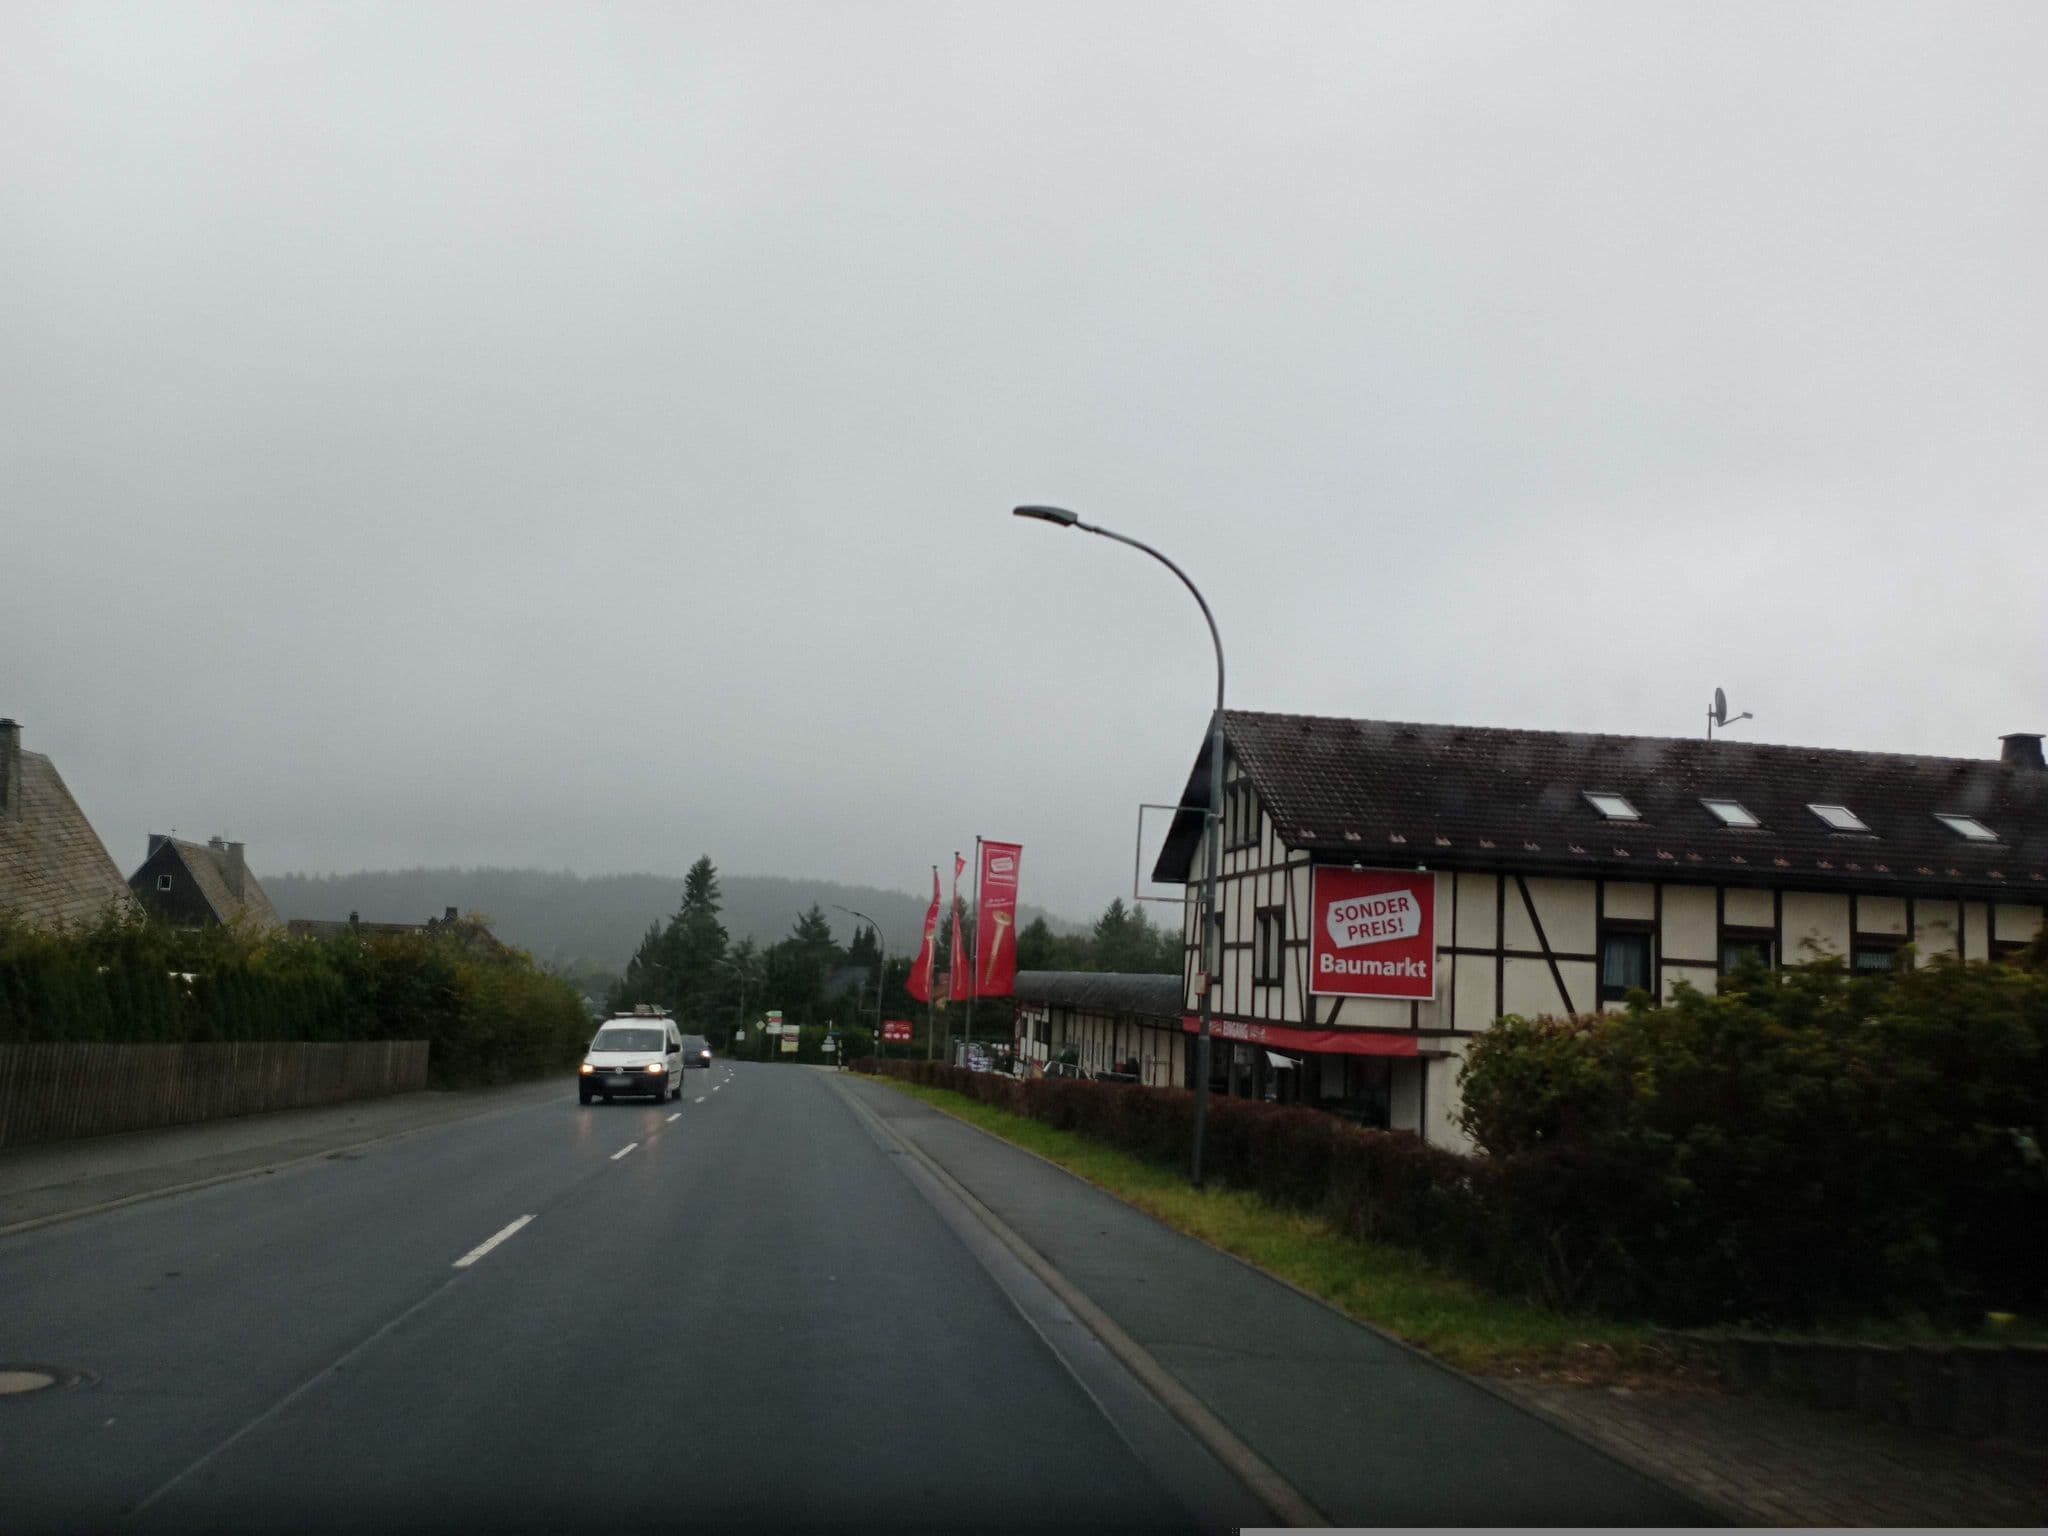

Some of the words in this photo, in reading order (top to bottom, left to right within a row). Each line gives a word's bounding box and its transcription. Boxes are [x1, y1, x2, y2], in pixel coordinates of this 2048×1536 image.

[1334, 897, 1410, 923] SONDER
[1347, 917, 1405, 940] PREIS!
[1320, 953, 1427, 978] Baumarkt
